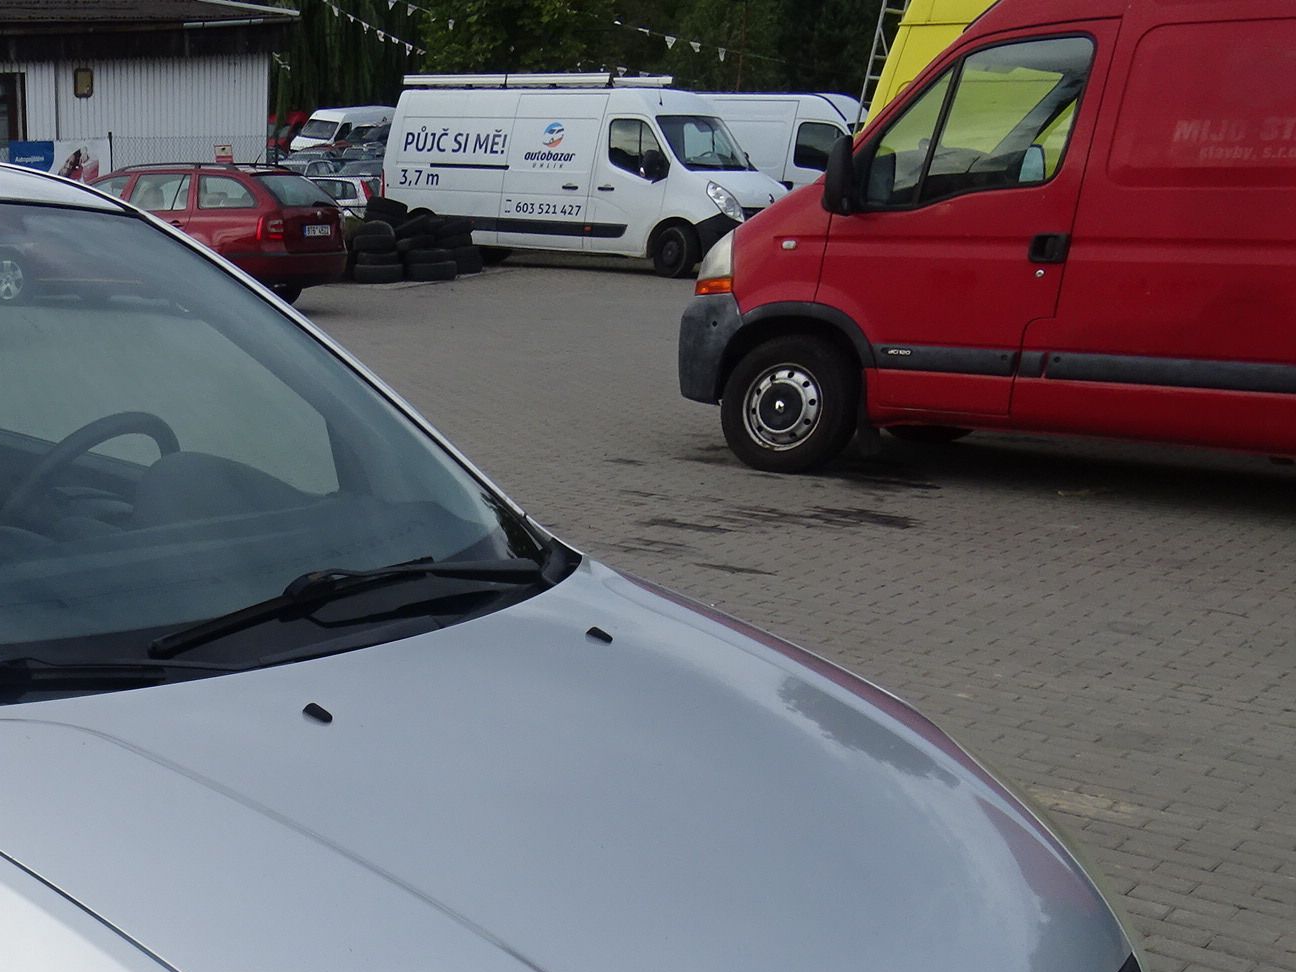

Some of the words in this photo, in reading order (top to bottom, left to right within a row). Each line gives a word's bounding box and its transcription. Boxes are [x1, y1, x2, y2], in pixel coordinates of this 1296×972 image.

[404, 126, 450, 153] PŮJČ
[451, 132, 470, 154] SI
[473, 129, 508, 155] MĚ!
[524, 150, 576, 162] autobazar
[399, 168, 423, 187] 3,7
[426, 173, 440, 186] m
[515, 201, 535, 215] 603
[537, 203, 558, 215] 521
[560, 204, 582, 217] 427
